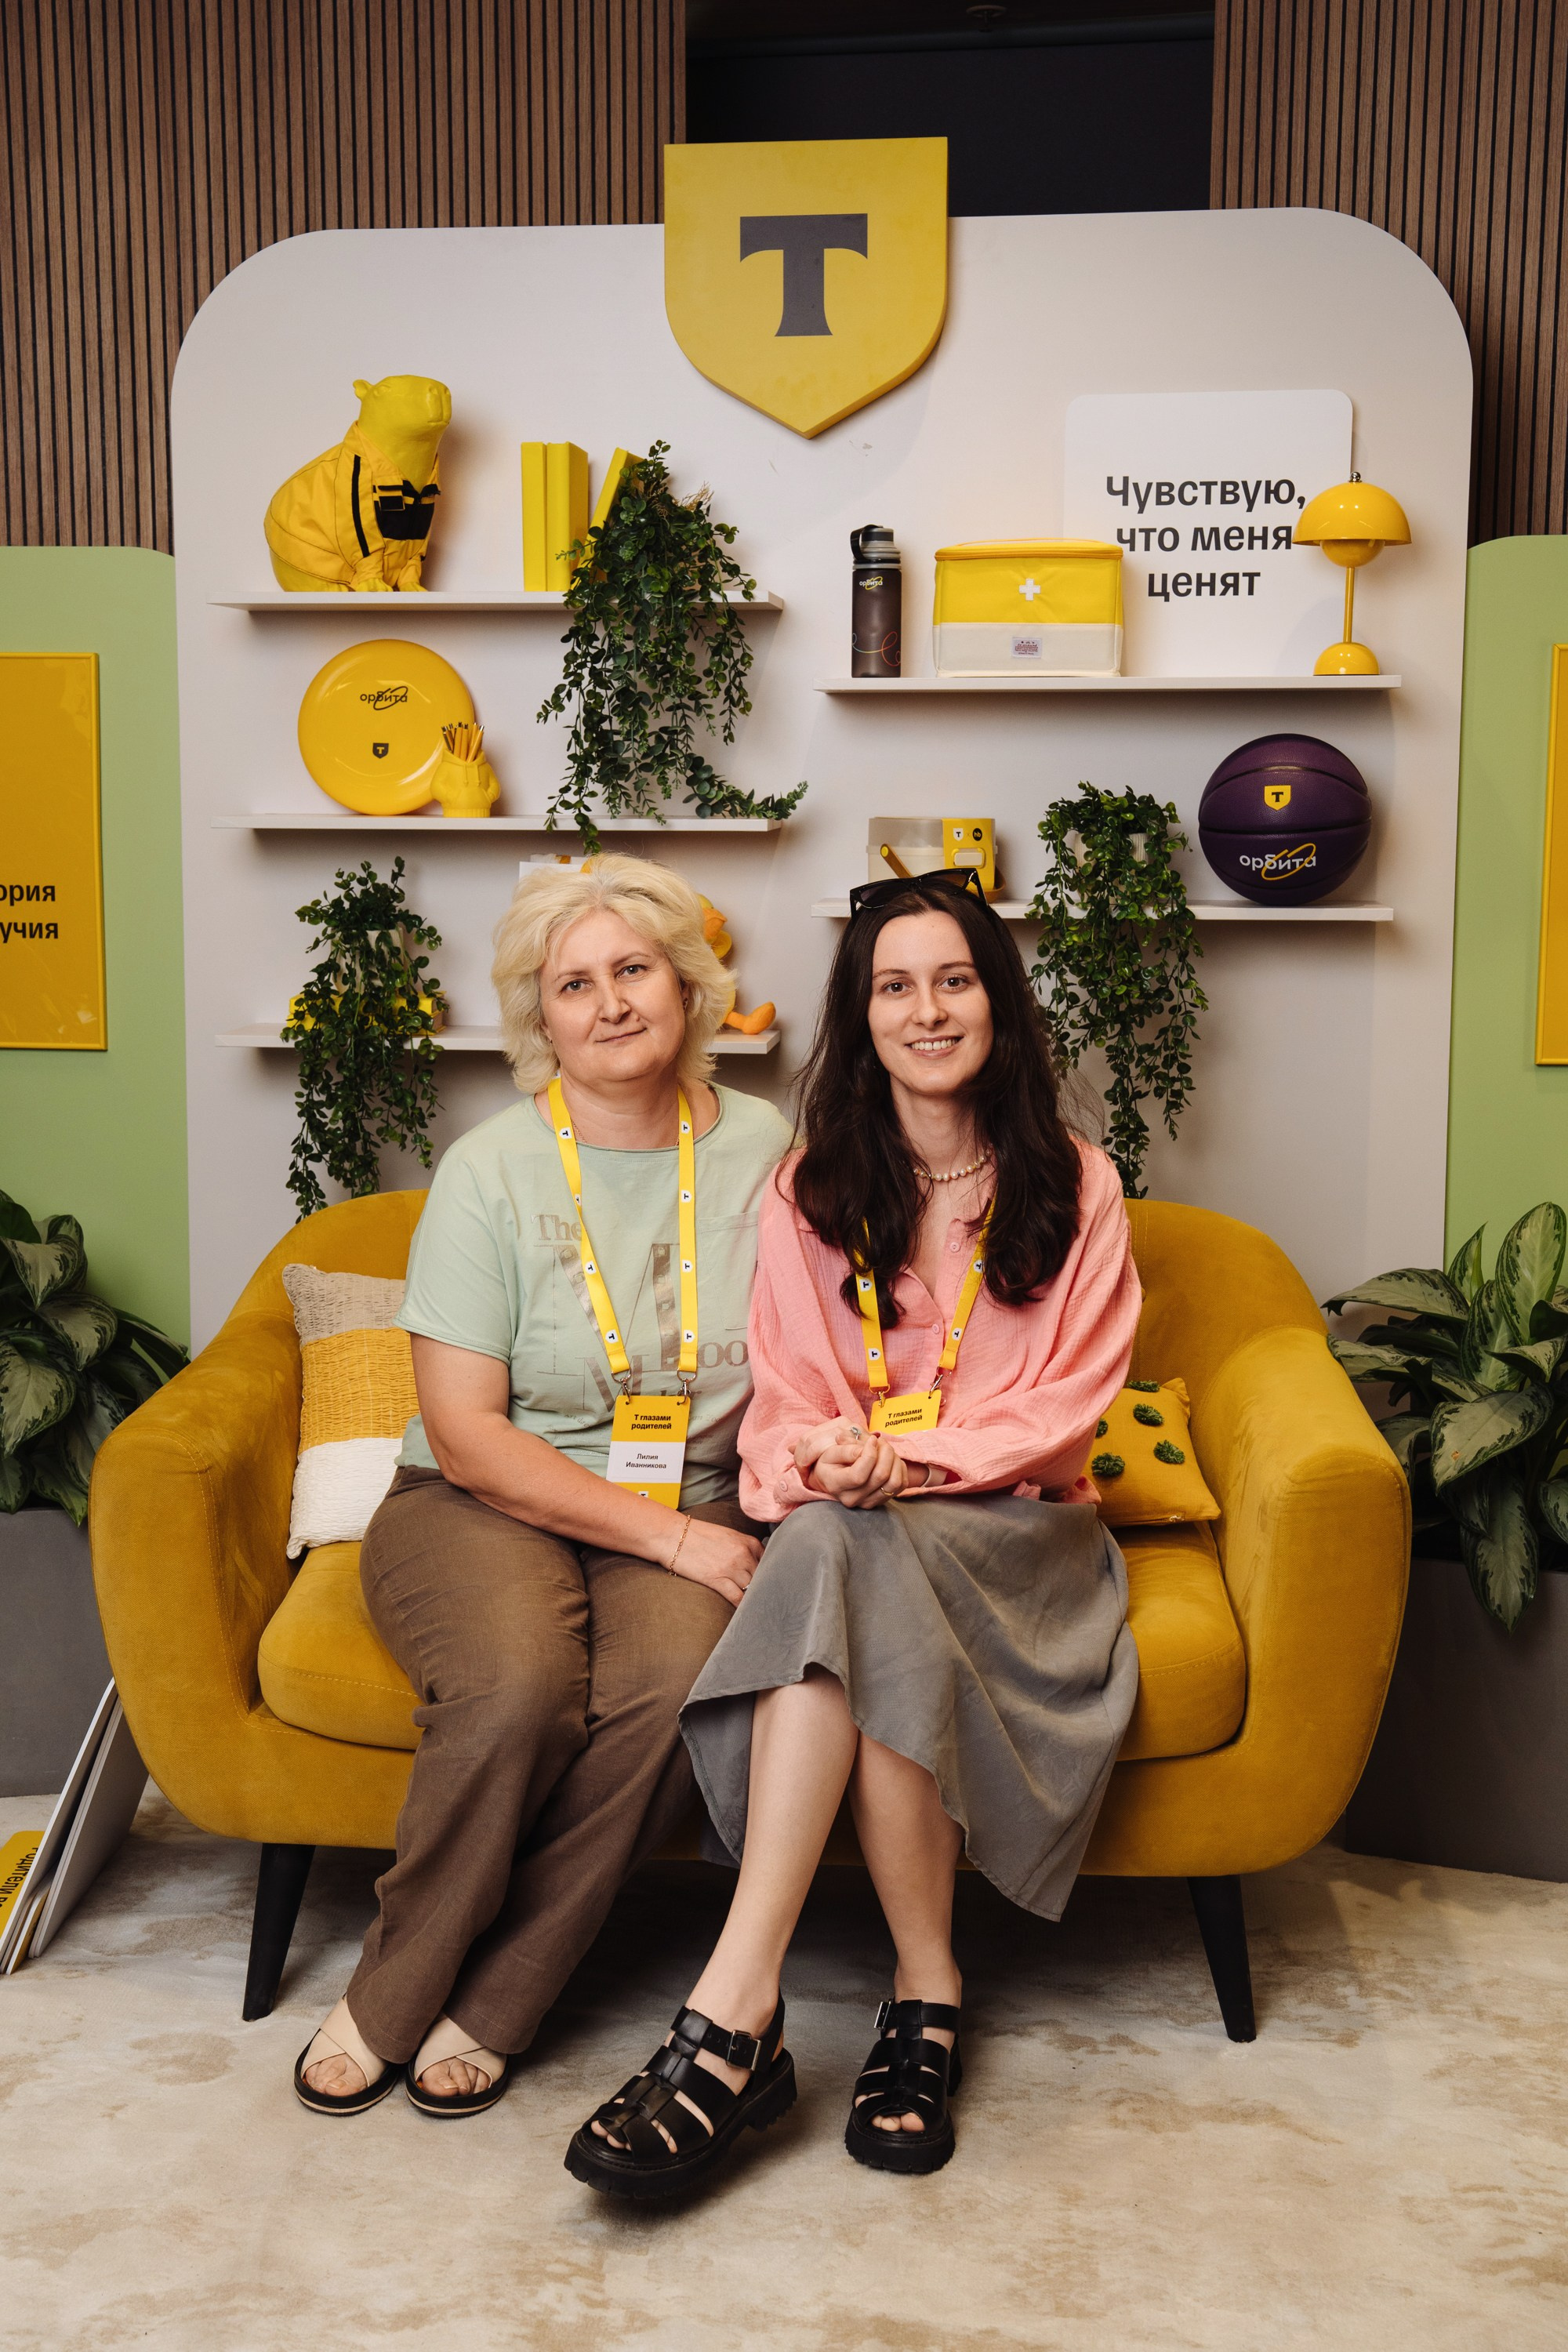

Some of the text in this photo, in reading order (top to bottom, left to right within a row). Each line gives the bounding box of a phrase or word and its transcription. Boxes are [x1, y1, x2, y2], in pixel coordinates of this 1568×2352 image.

[740, 213, 868, 337] Т
[1106, 476, 1305, 514] Чувствую,
[1116, 526, 1292, 552] что меня
[1148, 572, 1261, 602] ценят
[360, 691, 408, 704] орбита
[1239, 854, 1316, 871] орбита
[0, 922, 59, 943] учия
[885, 1415, 923, 1428] родителей
[893, 1409, 922, 1417] глазами
